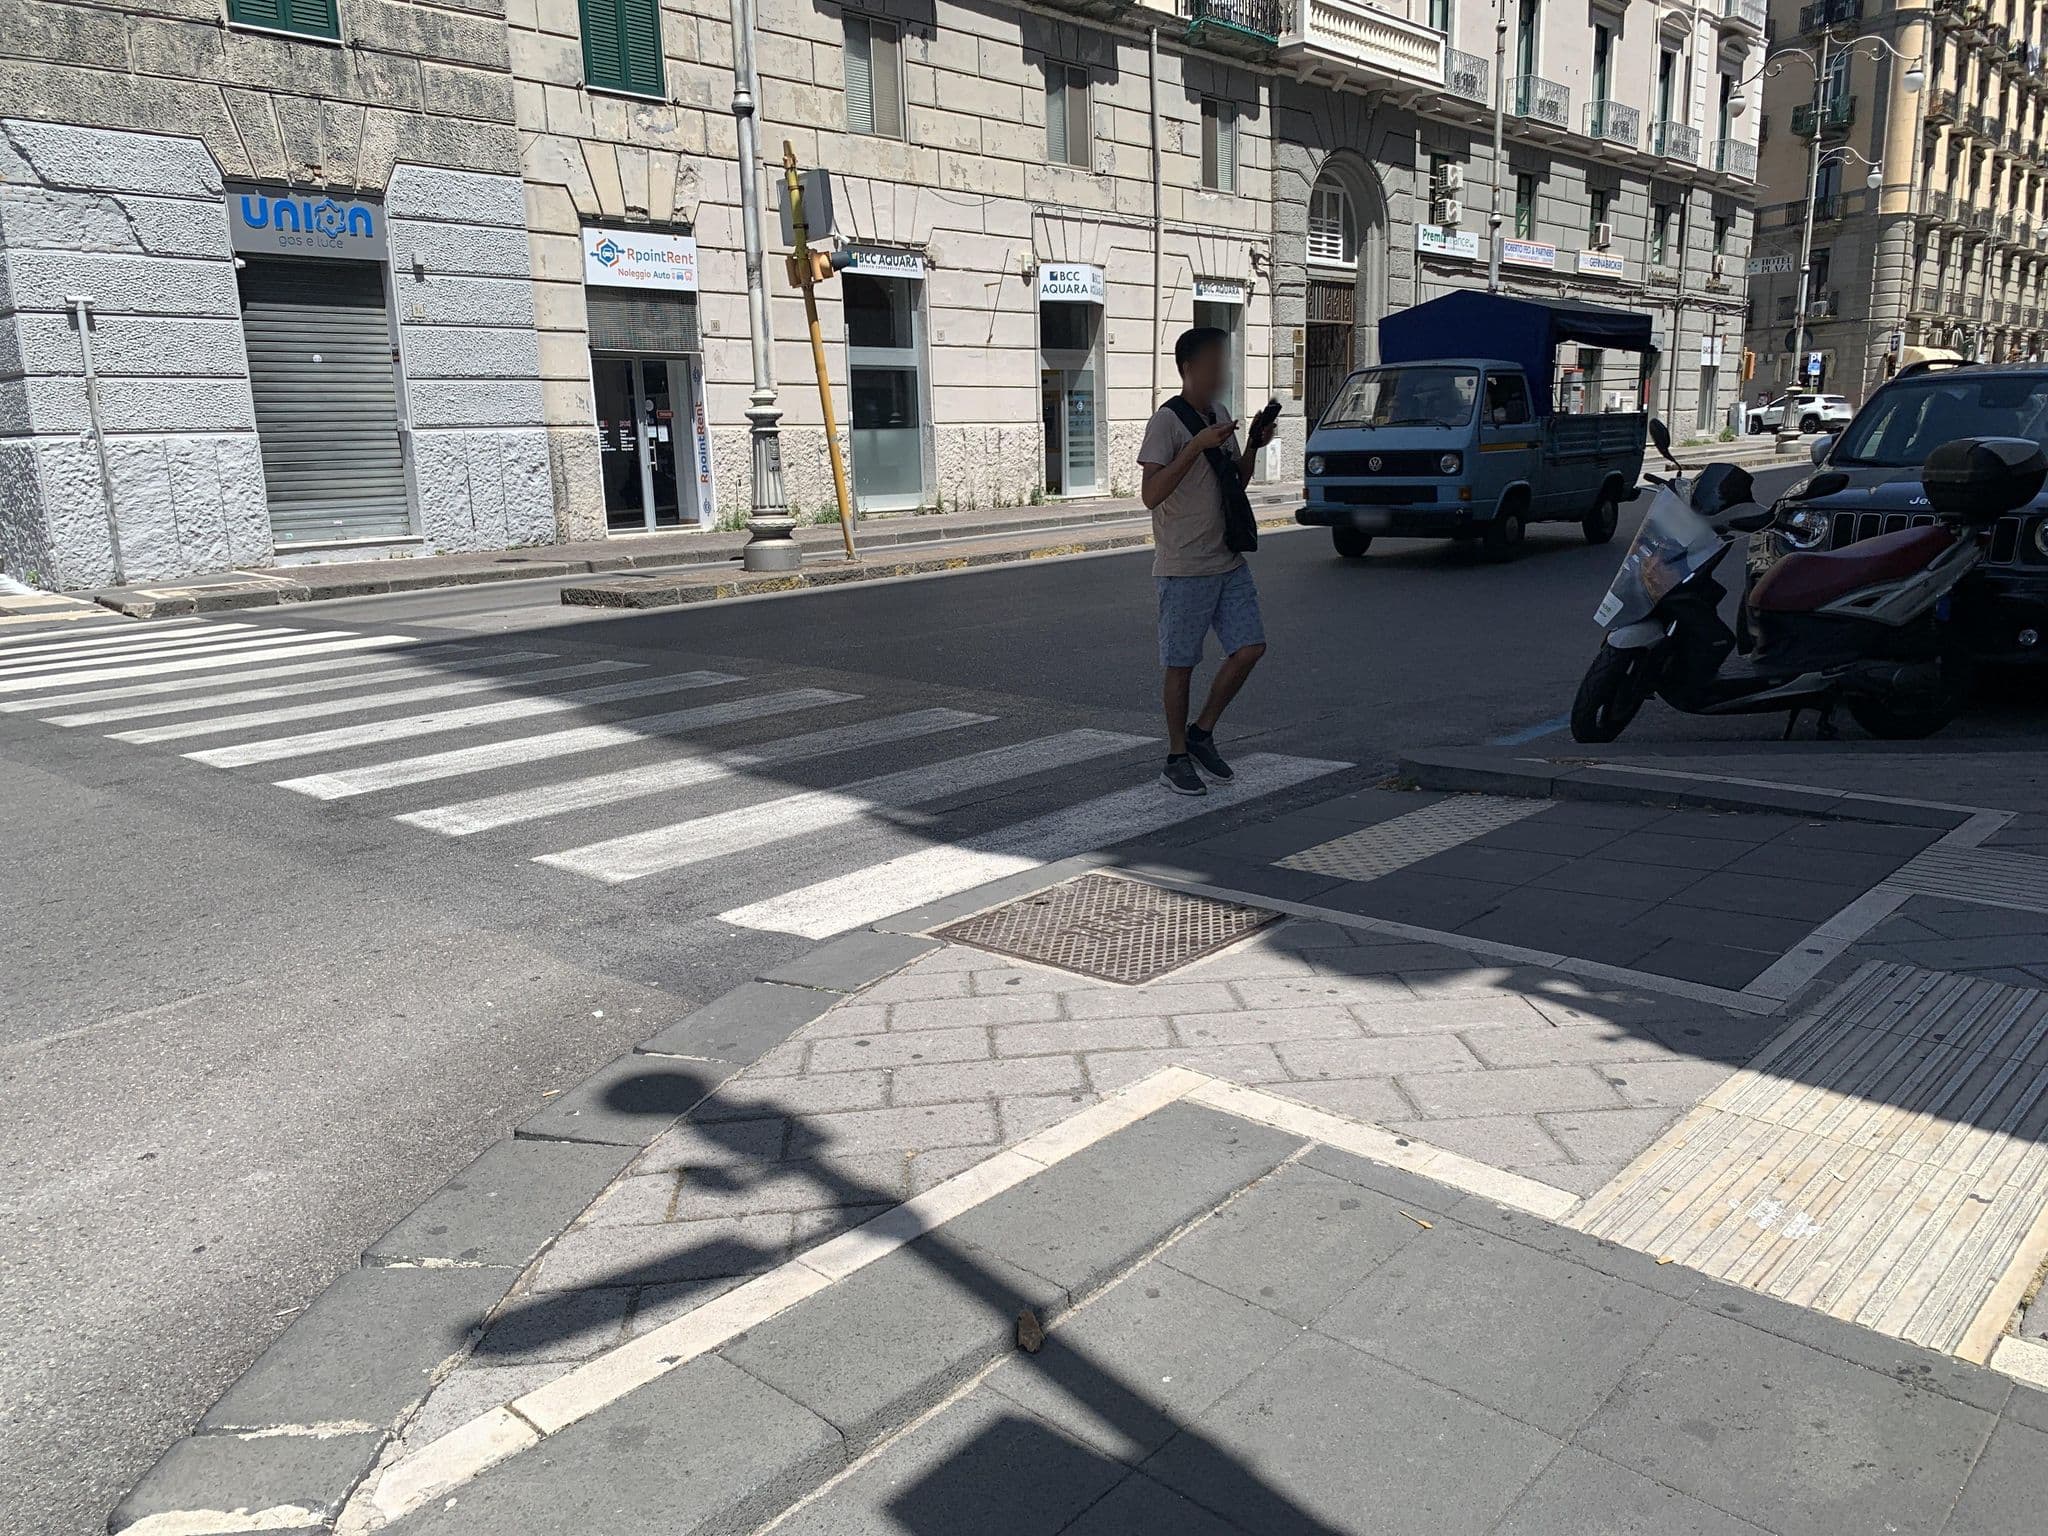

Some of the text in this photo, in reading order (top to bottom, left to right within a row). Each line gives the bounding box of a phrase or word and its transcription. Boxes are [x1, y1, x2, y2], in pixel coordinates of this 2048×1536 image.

[278, 235, 344, 249] gas e luce
[627, 247, 694, 265] RpointRent
[859, 252, 918, 269] BCC AQUARA
[1761, 256, 1792, 266] HOTEL
[617, 267, 671, 280] Noleggio Auto
[1761, 264, 1791, 273] PLAZA
[1060, 271, 1080, 281] BCC
[1041, 284, 1088, 294] AQUARA
[694, 400, 709, 484] RpointRent
[1909, 496, 1931, 505] Je
